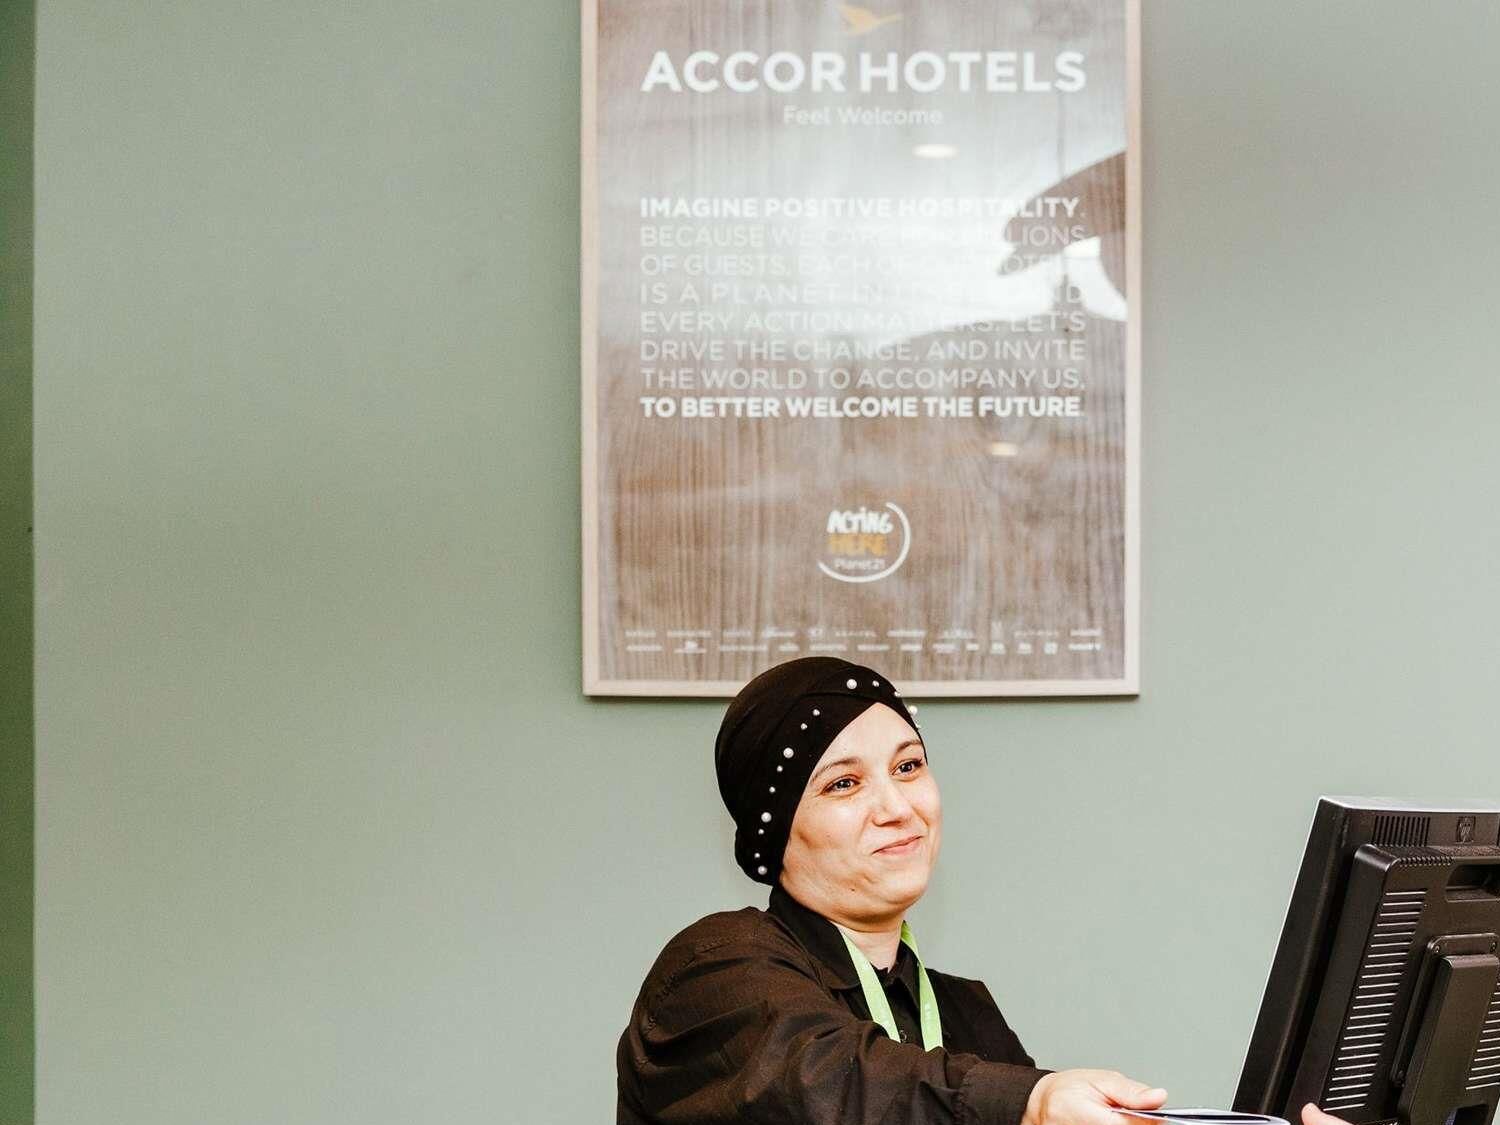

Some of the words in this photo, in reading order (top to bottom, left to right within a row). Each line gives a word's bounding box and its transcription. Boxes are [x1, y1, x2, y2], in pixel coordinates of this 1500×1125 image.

[640, 51, 847, 93] ACCOR
[860, 51, 1087, 93] HOTELS
[784, 105, 831, 126] Feel
[838, 105, 943, 126] Welcome
[640, 197, 760, 218] IMAGINE
[765, 197, 891, 218] POSITIVE
[640, 226, 765, 247] BECAUSE
[772, 226, 816, 247] WE
[640, 255, 677, 275] OF
[683, 255, 791, 276] GUESTS.
[798, 255, 870, 275] EACH
[640, 283, 669, 304] IS
[679, 283, 699, 304] A
[712, 283, 841, 304] PLANET
[640, 311, 734, 332] EVERY
[743, 311, 852, 332] ACTION
[1009, 311, 1087, 333] LET'S
[640, 340, 724, 361] DRIVE
[733, 340, 787, 361] THE
[926, 340, 987, 361] AND
[994, 340, 1087, 361] INVITE
[640, 368, 696, 389] THE
[700, 368, 808, 389] WORLD
[813, 368, 850, 389] TO
[856, 368, 1036, 389] ACCOMPANY
[1042, 368, 1086, 389] US.
[639, 396, 676, 418] TO
[681, 396, 780, 418] BETTER
[785, 396, 919, 418] WELCOME
[923, 396, 974, 418] THE
[979, 396, 1086, 418] FUTURE.
